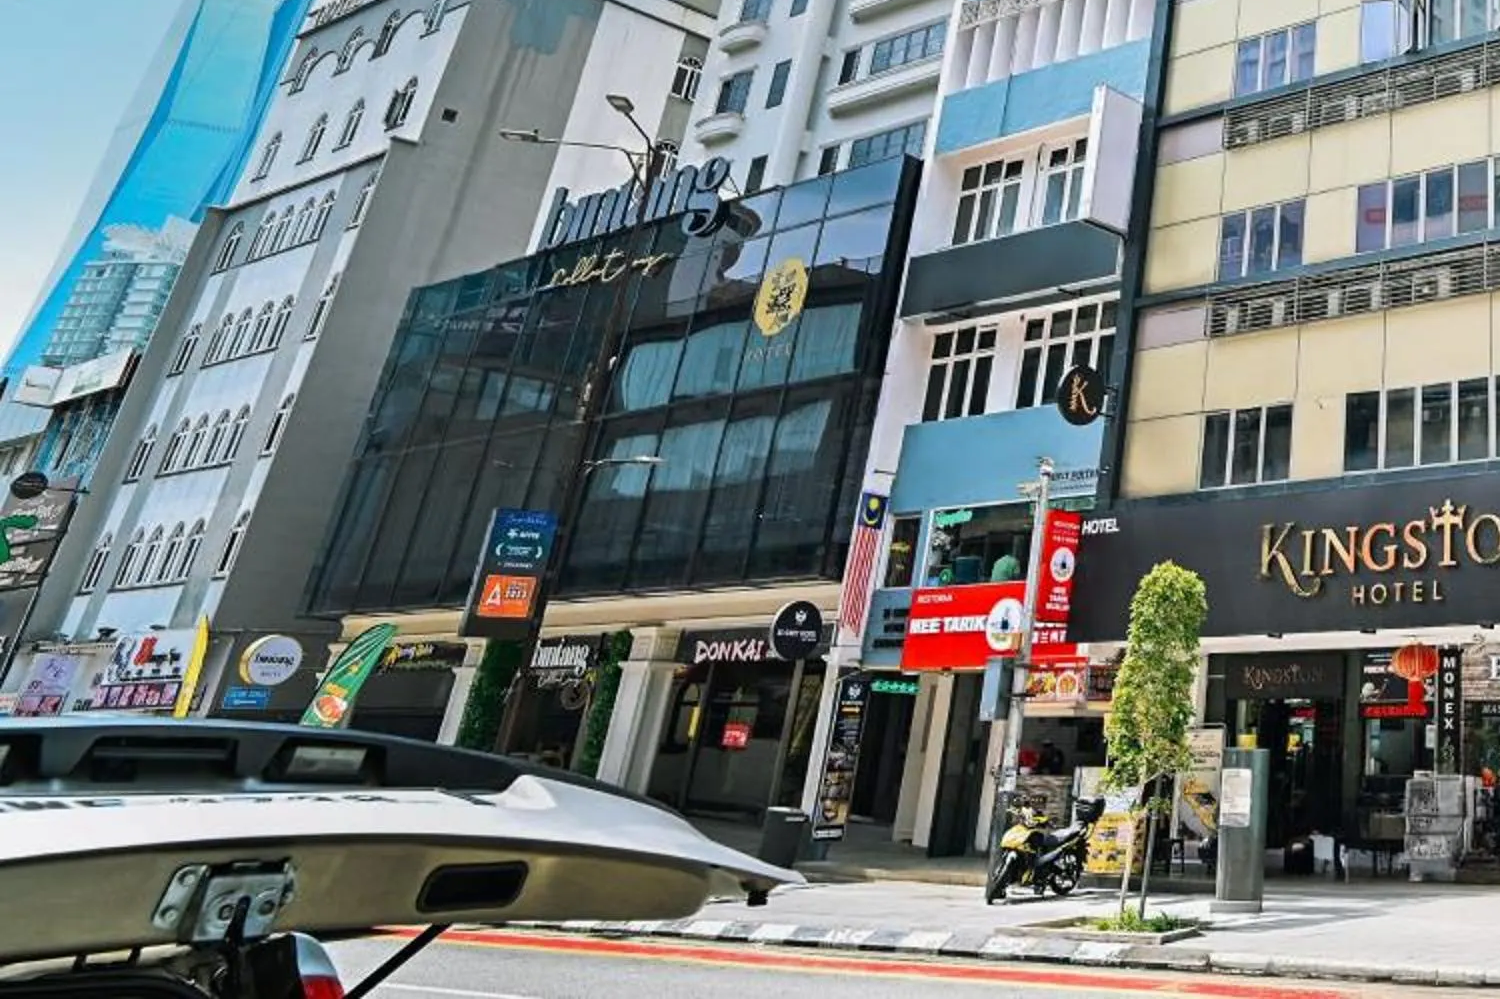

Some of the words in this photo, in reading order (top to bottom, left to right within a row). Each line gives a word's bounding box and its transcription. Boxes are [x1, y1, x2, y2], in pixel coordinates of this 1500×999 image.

[1082, 518, 1119, 535] HOTEL
[1352, 579, 1443, 604] HOTEL
[1442, 656, 1456, 730] MONEX
